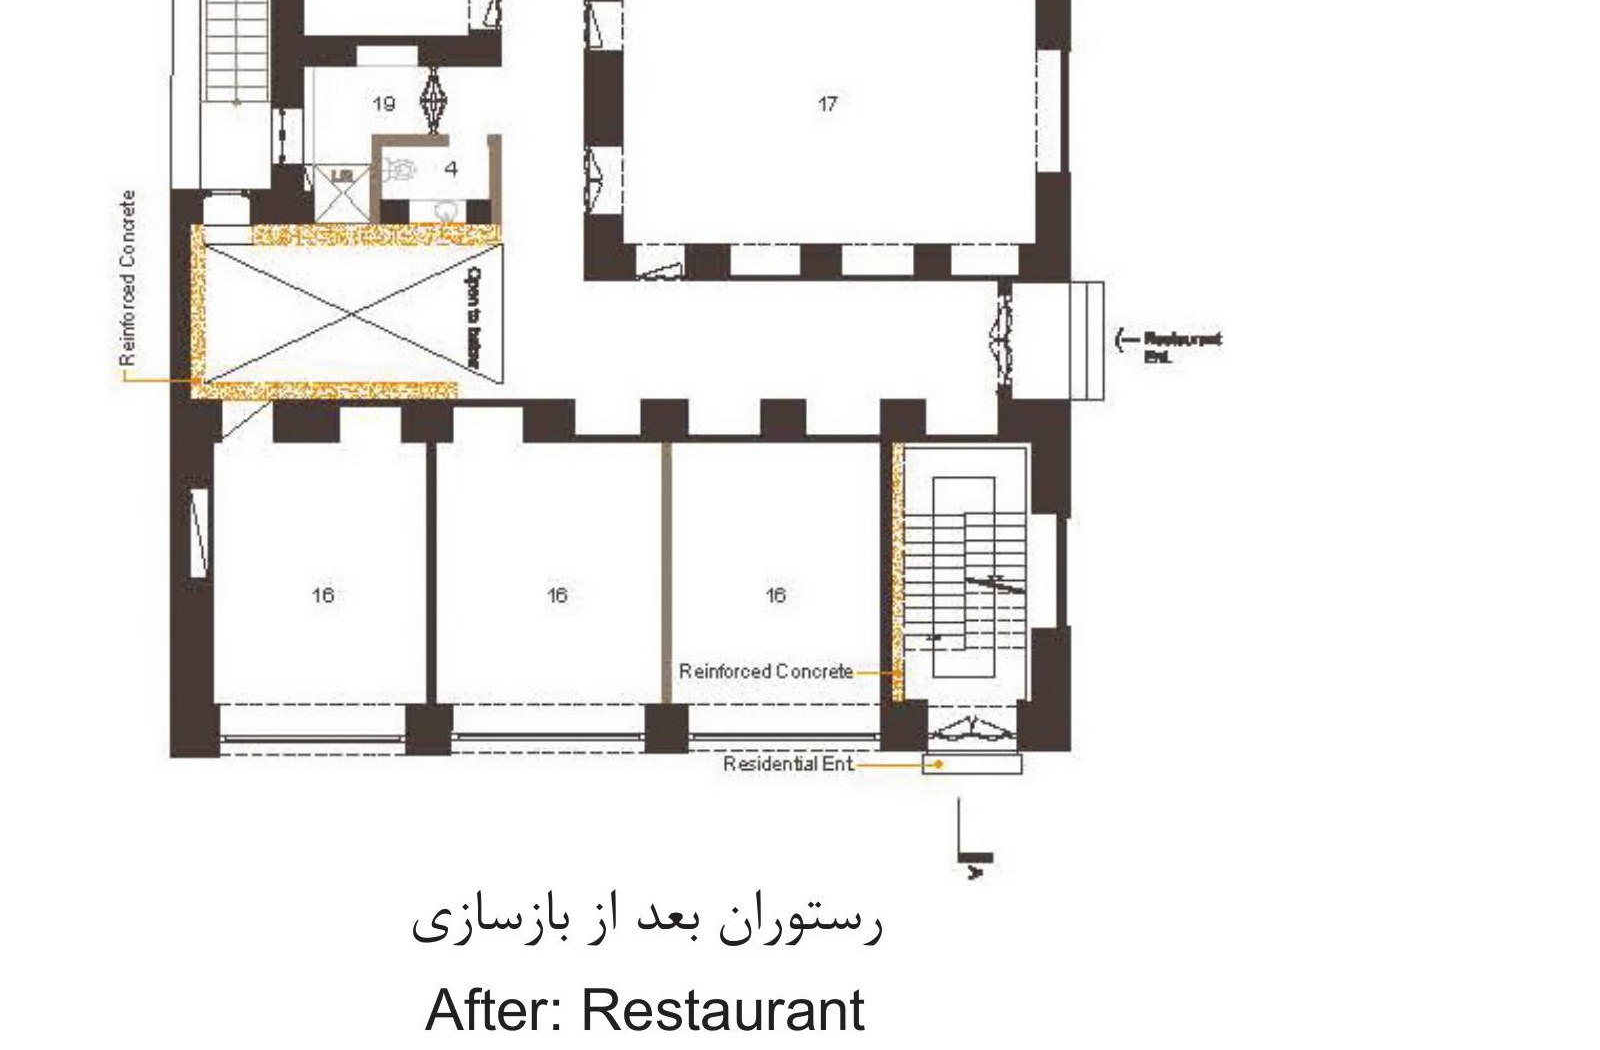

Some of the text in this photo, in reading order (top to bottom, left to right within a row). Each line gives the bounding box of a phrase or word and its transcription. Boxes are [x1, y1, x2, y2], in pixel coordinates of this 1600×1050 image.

[373, 95, 396, 112] 19
[818, 95, 839, 112] 17
[444, 160, 458, 177] 4
[118, 190, 135, 366] Reinforced Concrete
[312, 587, 335, 604] 16
[547, 587, 568, 604] 16
[766, 587, 787, 604] 16
[679, 663, 854, 679] Reinforced Concrete
[723, 755, 818, 772] Residential
